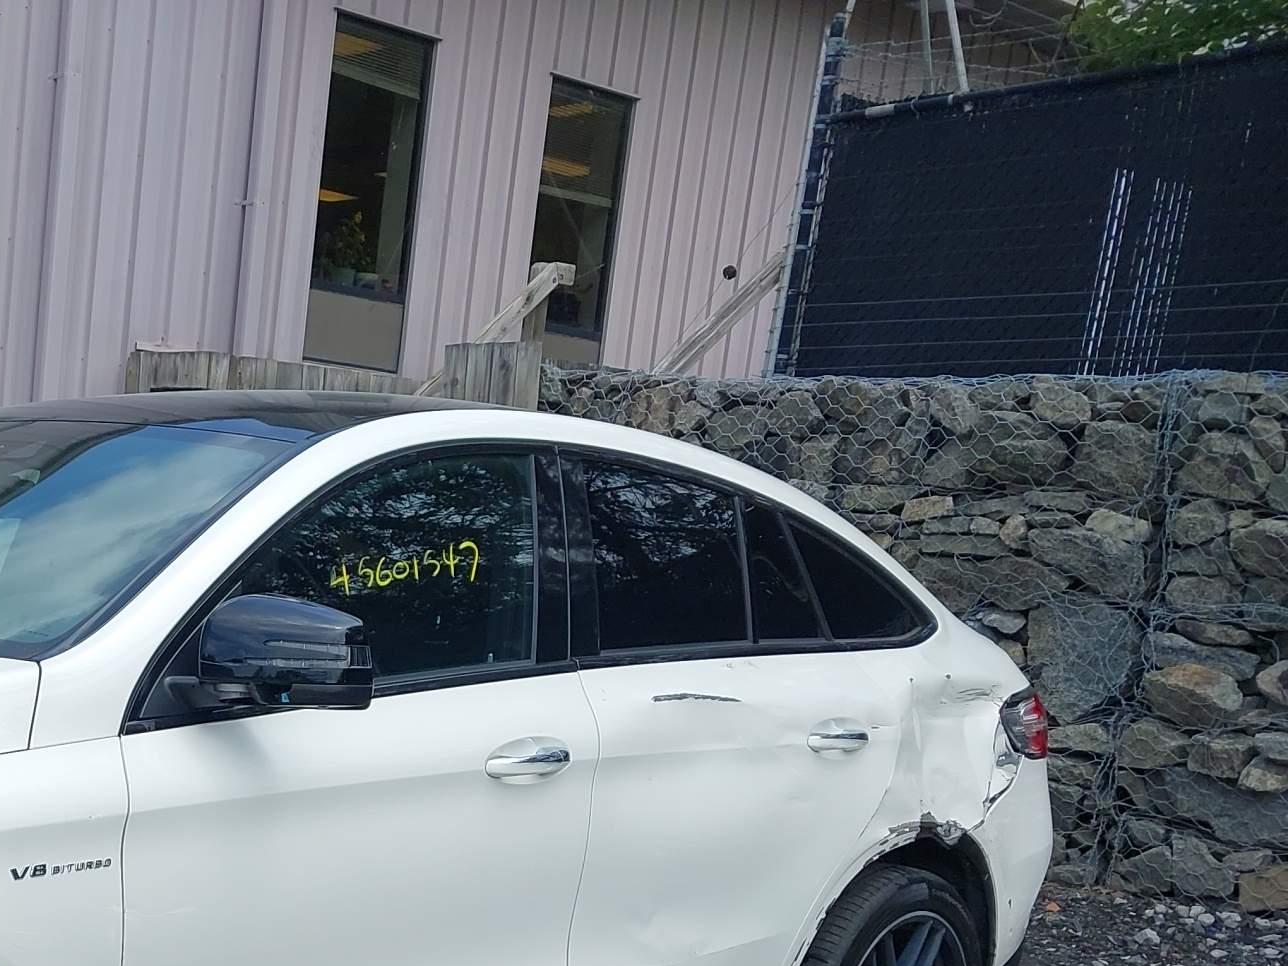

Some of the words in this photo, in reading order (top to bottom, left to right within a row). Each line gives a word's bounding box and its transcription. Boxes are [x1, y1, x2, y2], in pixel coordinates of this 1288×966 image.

[330, 540, 480, 596] 45601547
[10, 863, 47, 881] V8
[51, 858, 112, 876] BITURBO
